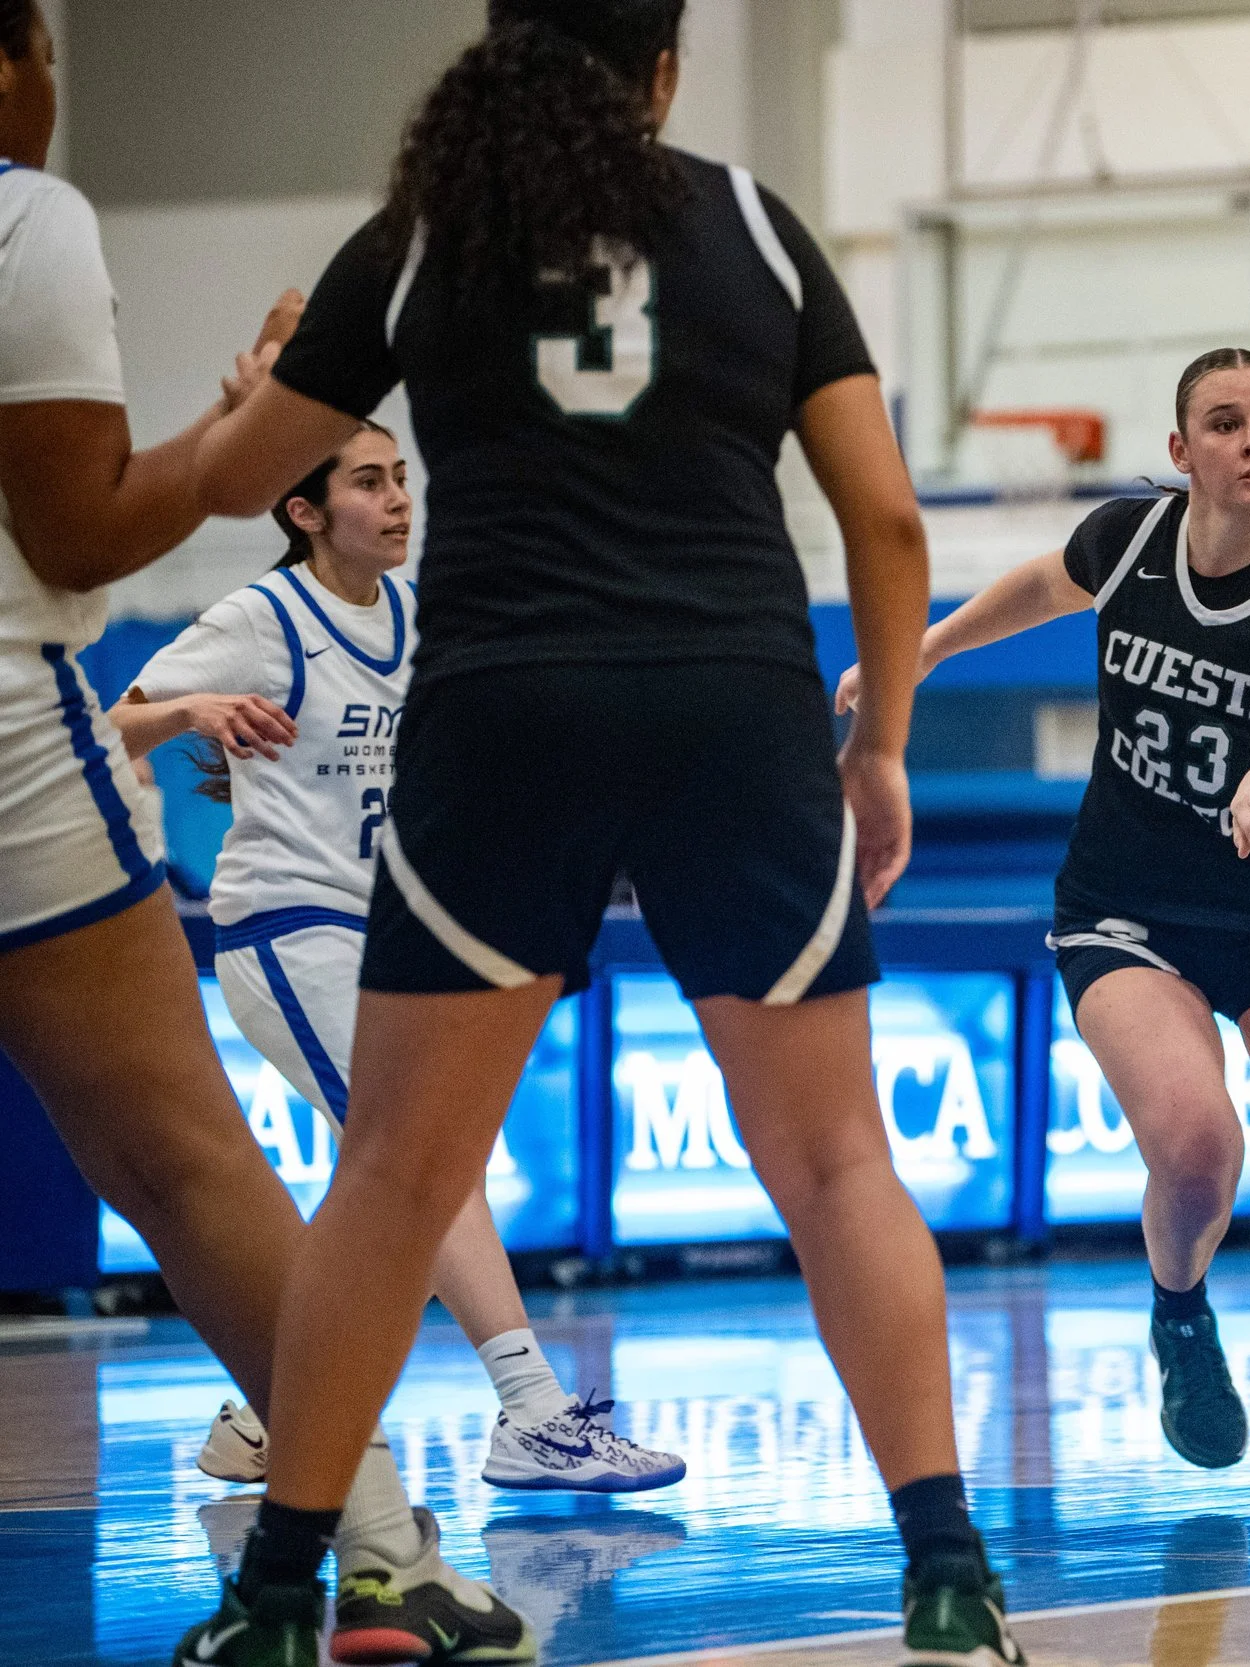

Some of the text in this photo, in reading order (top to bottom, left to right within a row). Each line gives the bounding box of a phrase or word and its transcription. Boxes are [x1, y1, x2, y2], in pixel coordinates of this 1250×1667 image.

[531, 234, 656, 416] 3
[337, 704, 407, 737] SM
[344, 745, 397, 757] WOME
[1134, 706, 1231, 796] 23
[316, 764, 396, 776] BASKET
